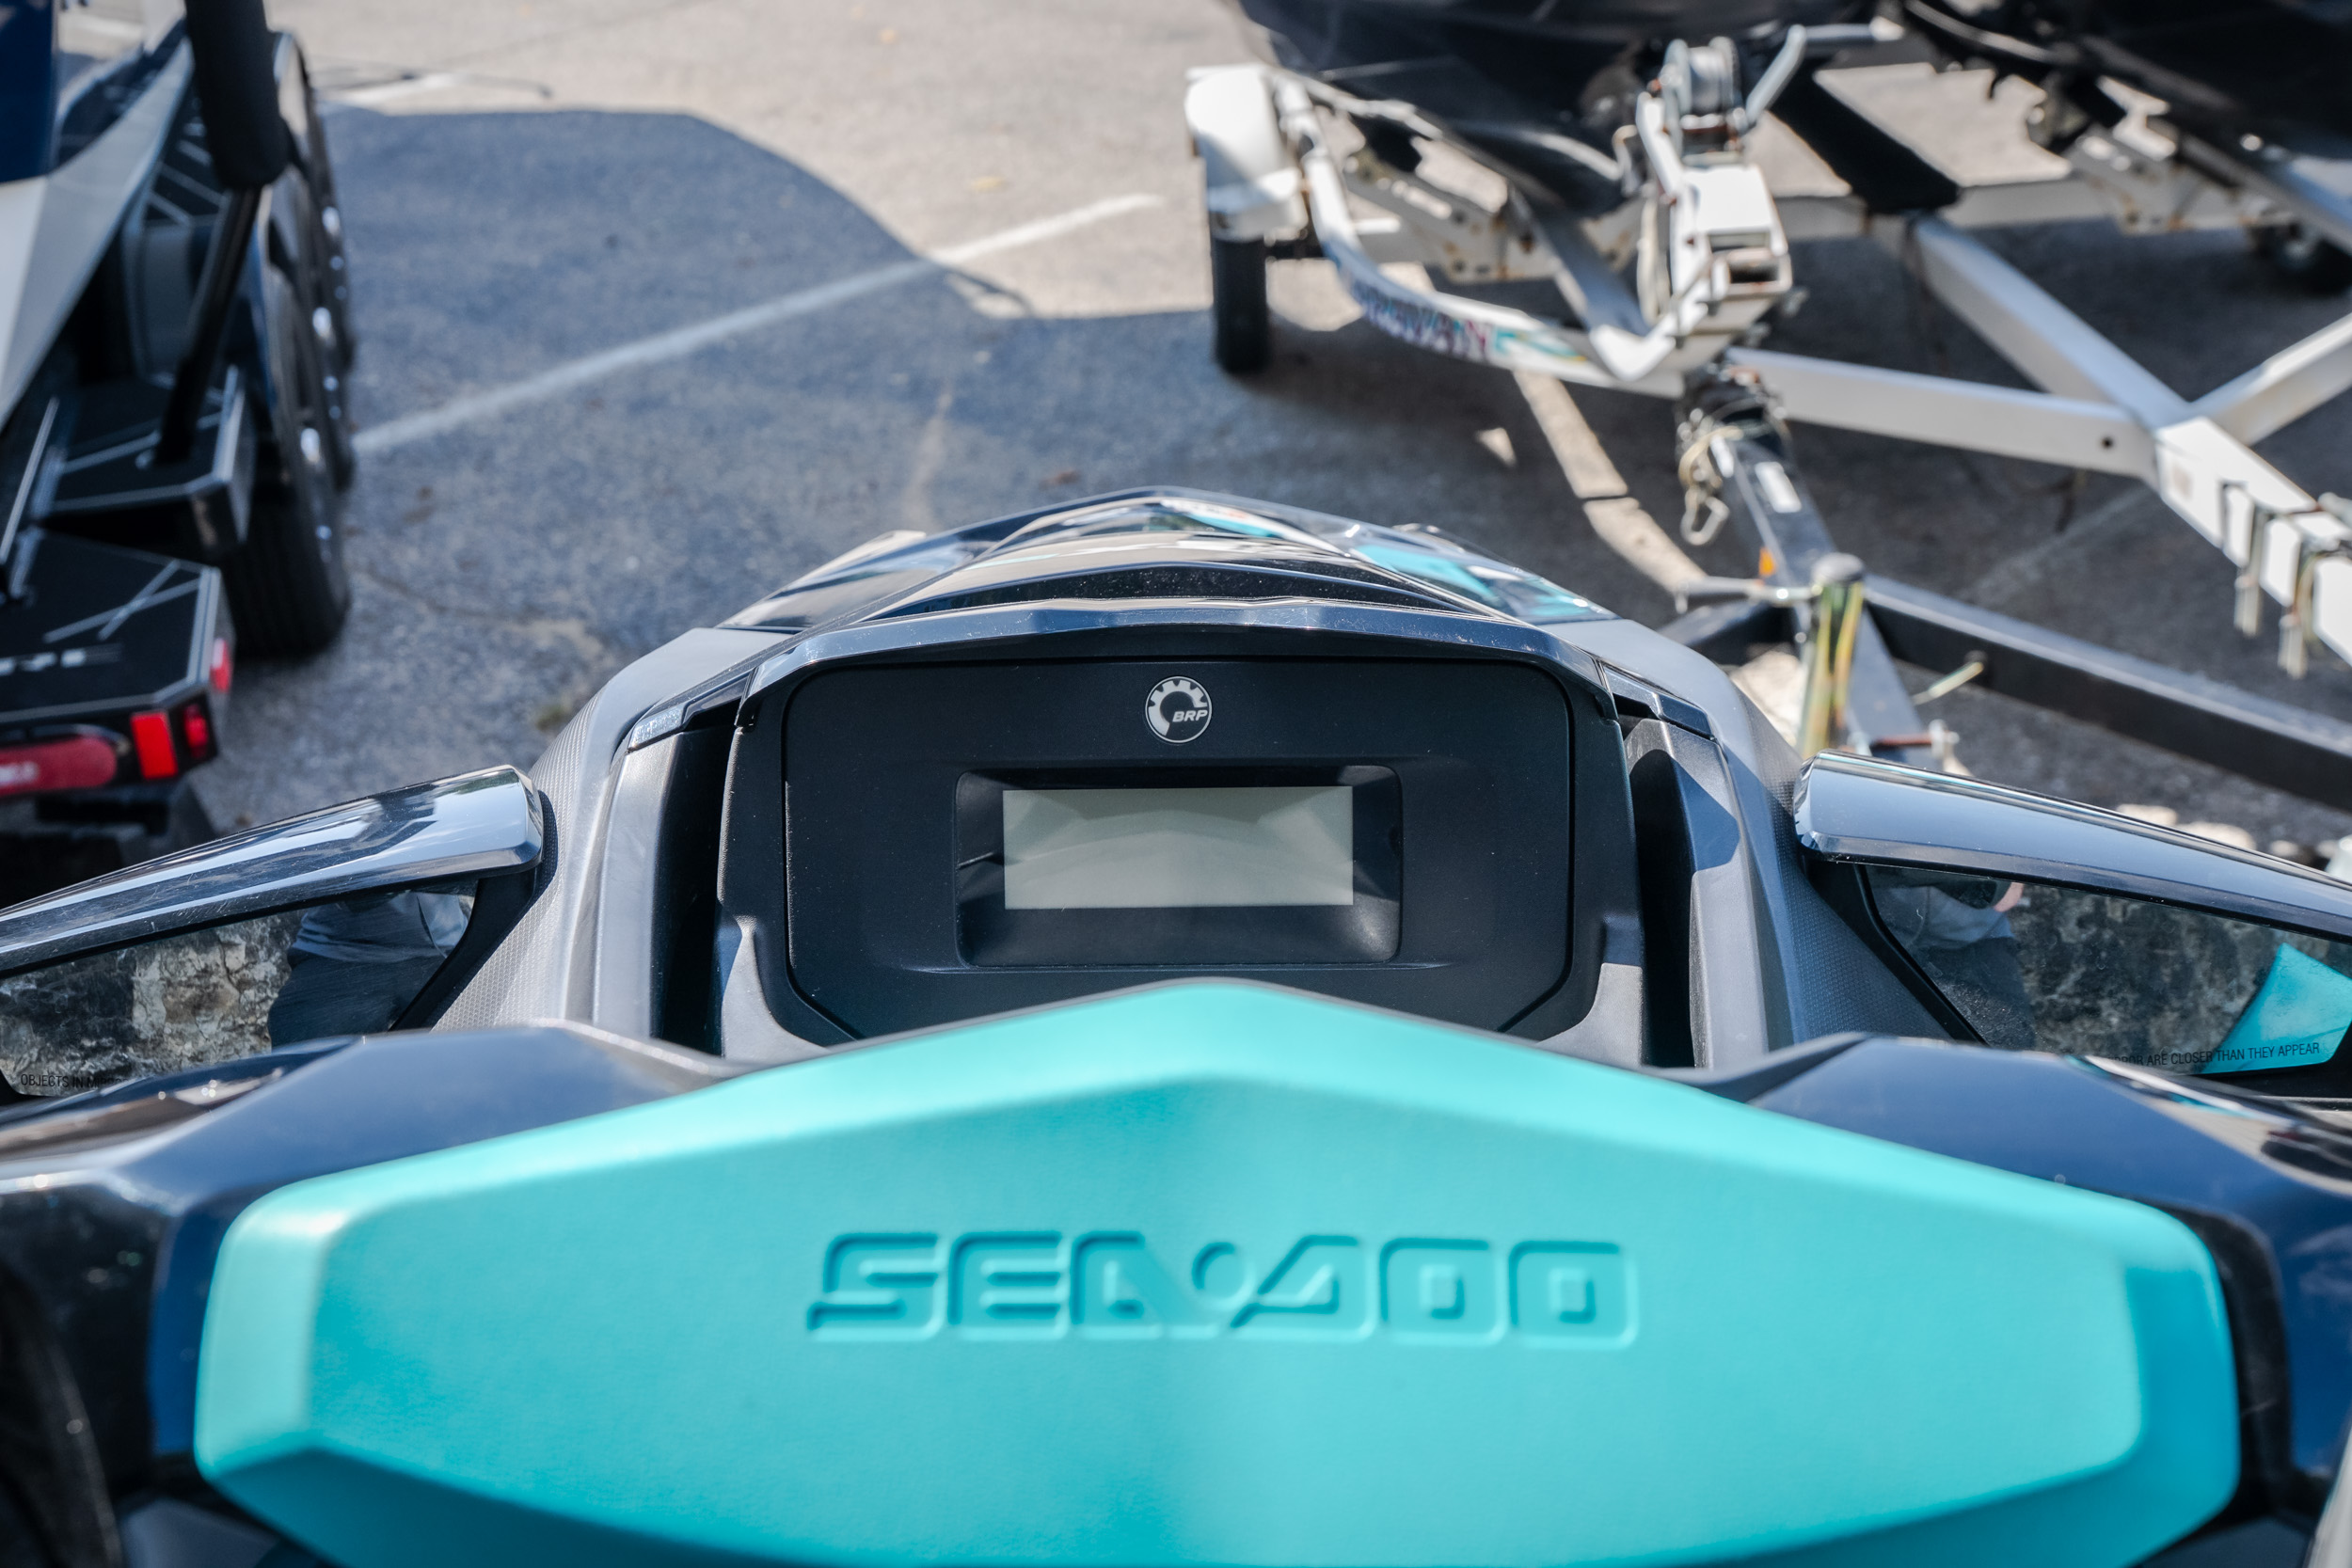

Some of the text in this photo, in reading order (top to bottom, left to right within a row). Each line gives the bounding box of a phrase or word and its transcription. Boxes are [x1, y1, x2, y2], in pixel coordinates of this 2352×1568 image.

[1172, 709, 1208, 722] BRP
[2147, 1053, 2168, 1066] ARE
[2170, 1051, 2212, 1065] CLOSER
[2217, 1048, 2245, 1061] THAN
[2248, 1045, 2275, 1059] THEY
[2278, 1042, 2320, 1056] APPEAR
[20, 1073, 70, 1088] OBJECTS
[72, 1076, 84, 1088] IN
